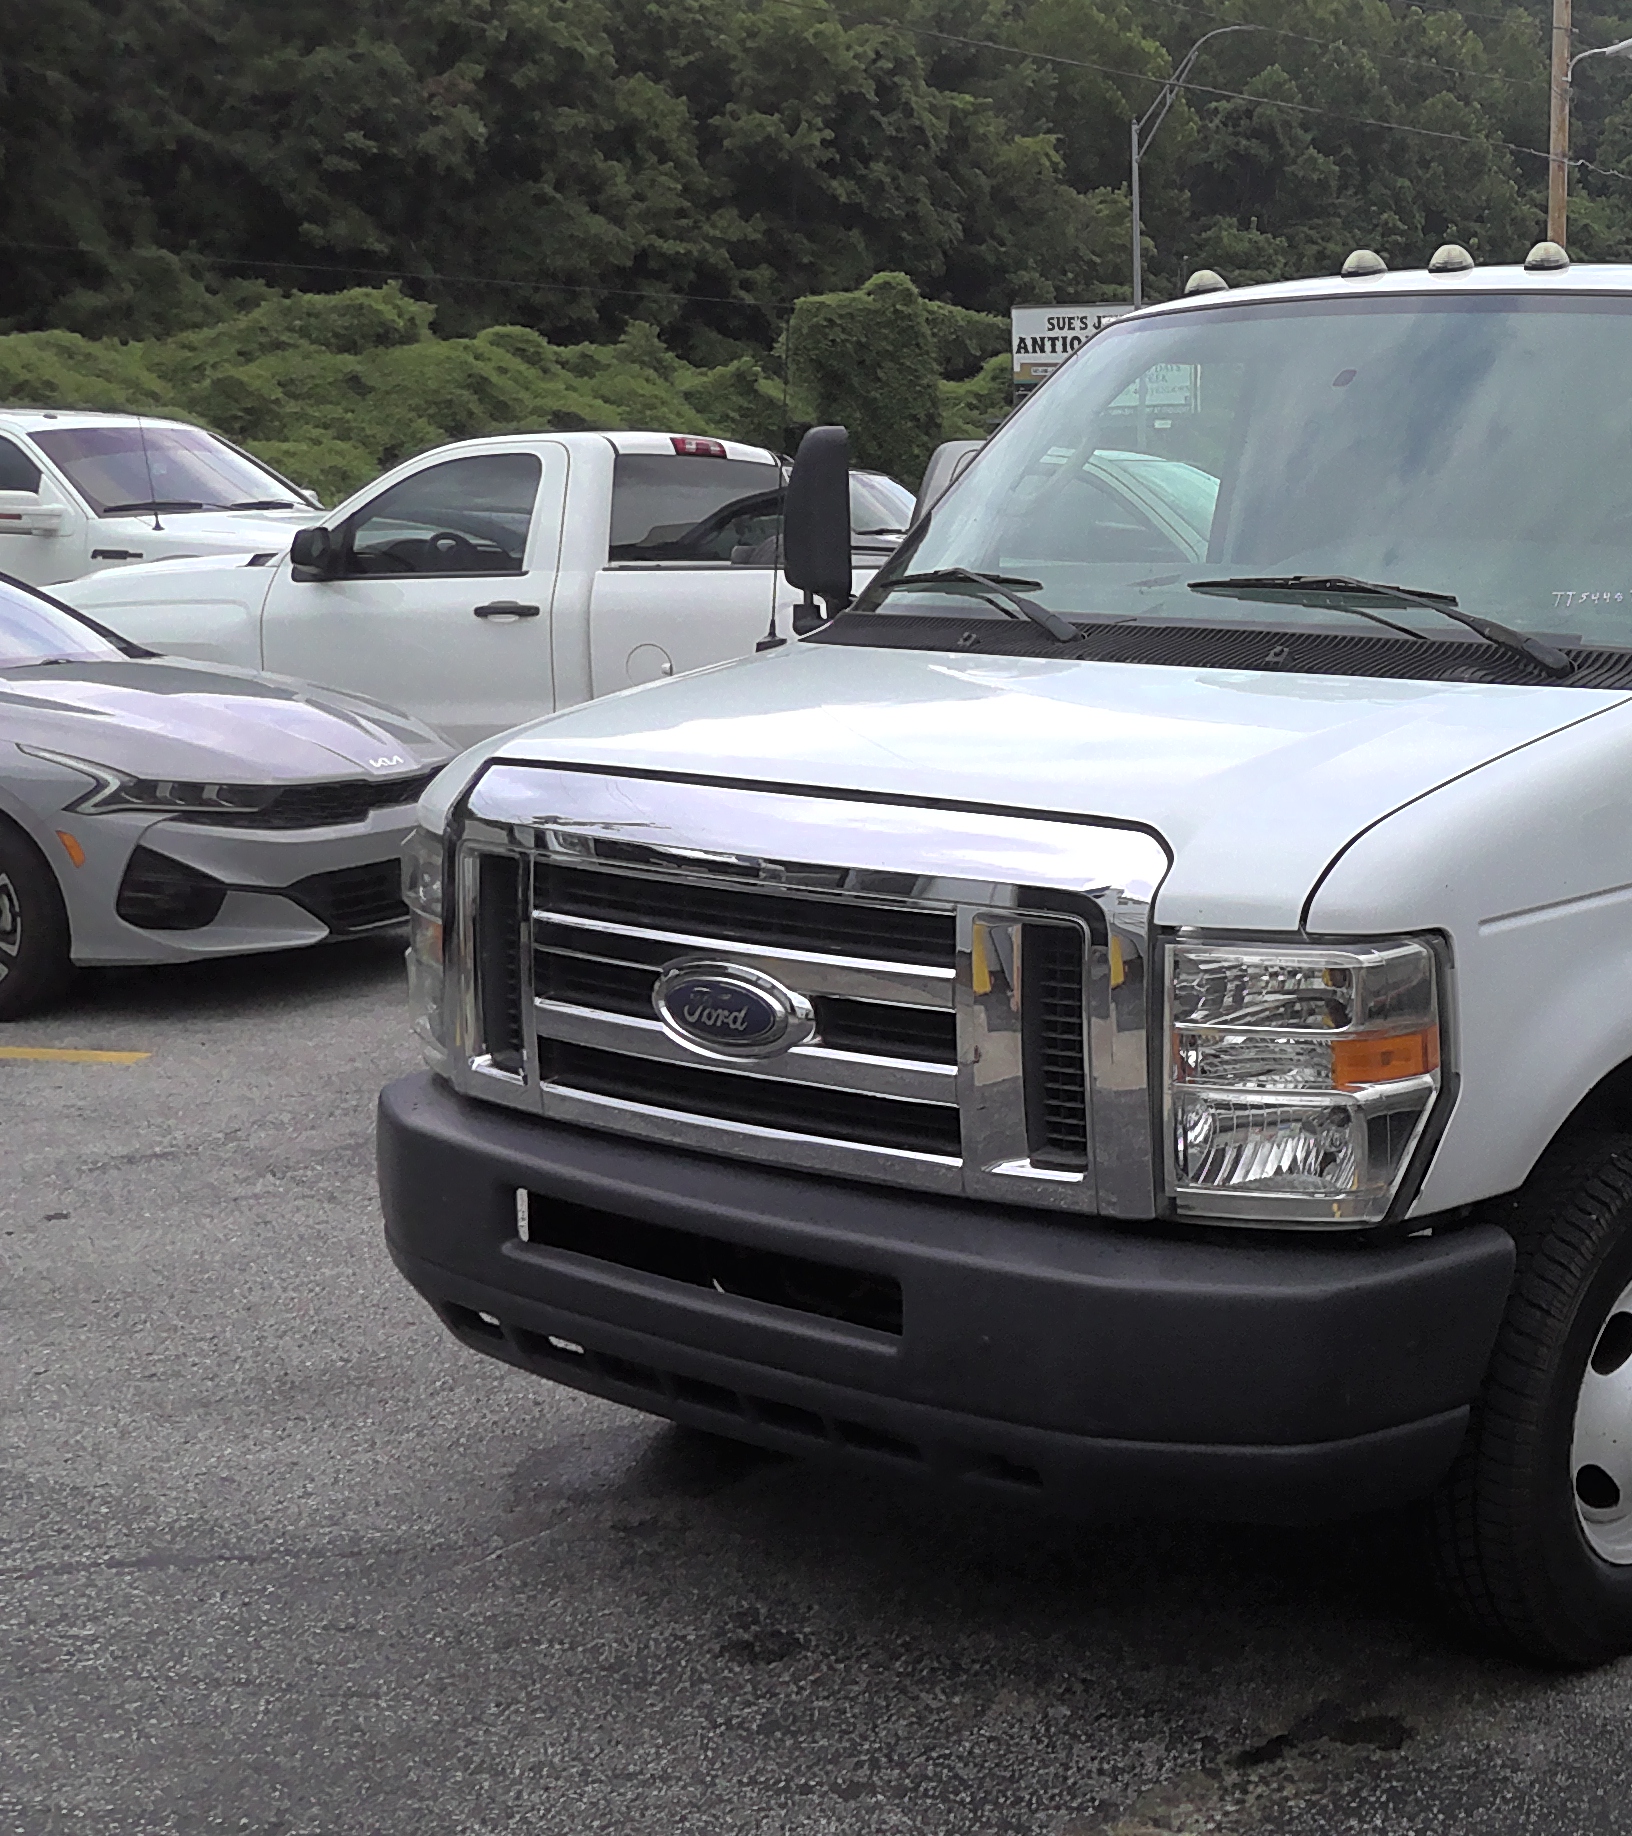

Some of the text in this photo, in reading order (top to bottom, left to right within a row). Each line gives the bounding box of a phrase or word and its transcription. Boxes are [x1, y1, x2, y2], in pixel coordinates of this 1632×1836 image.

[1047, 315, 1088, 331] SUE'S
[1015, 336, 1088, 355] ANTIQ
[683, 990, 750, 1032] Ford
